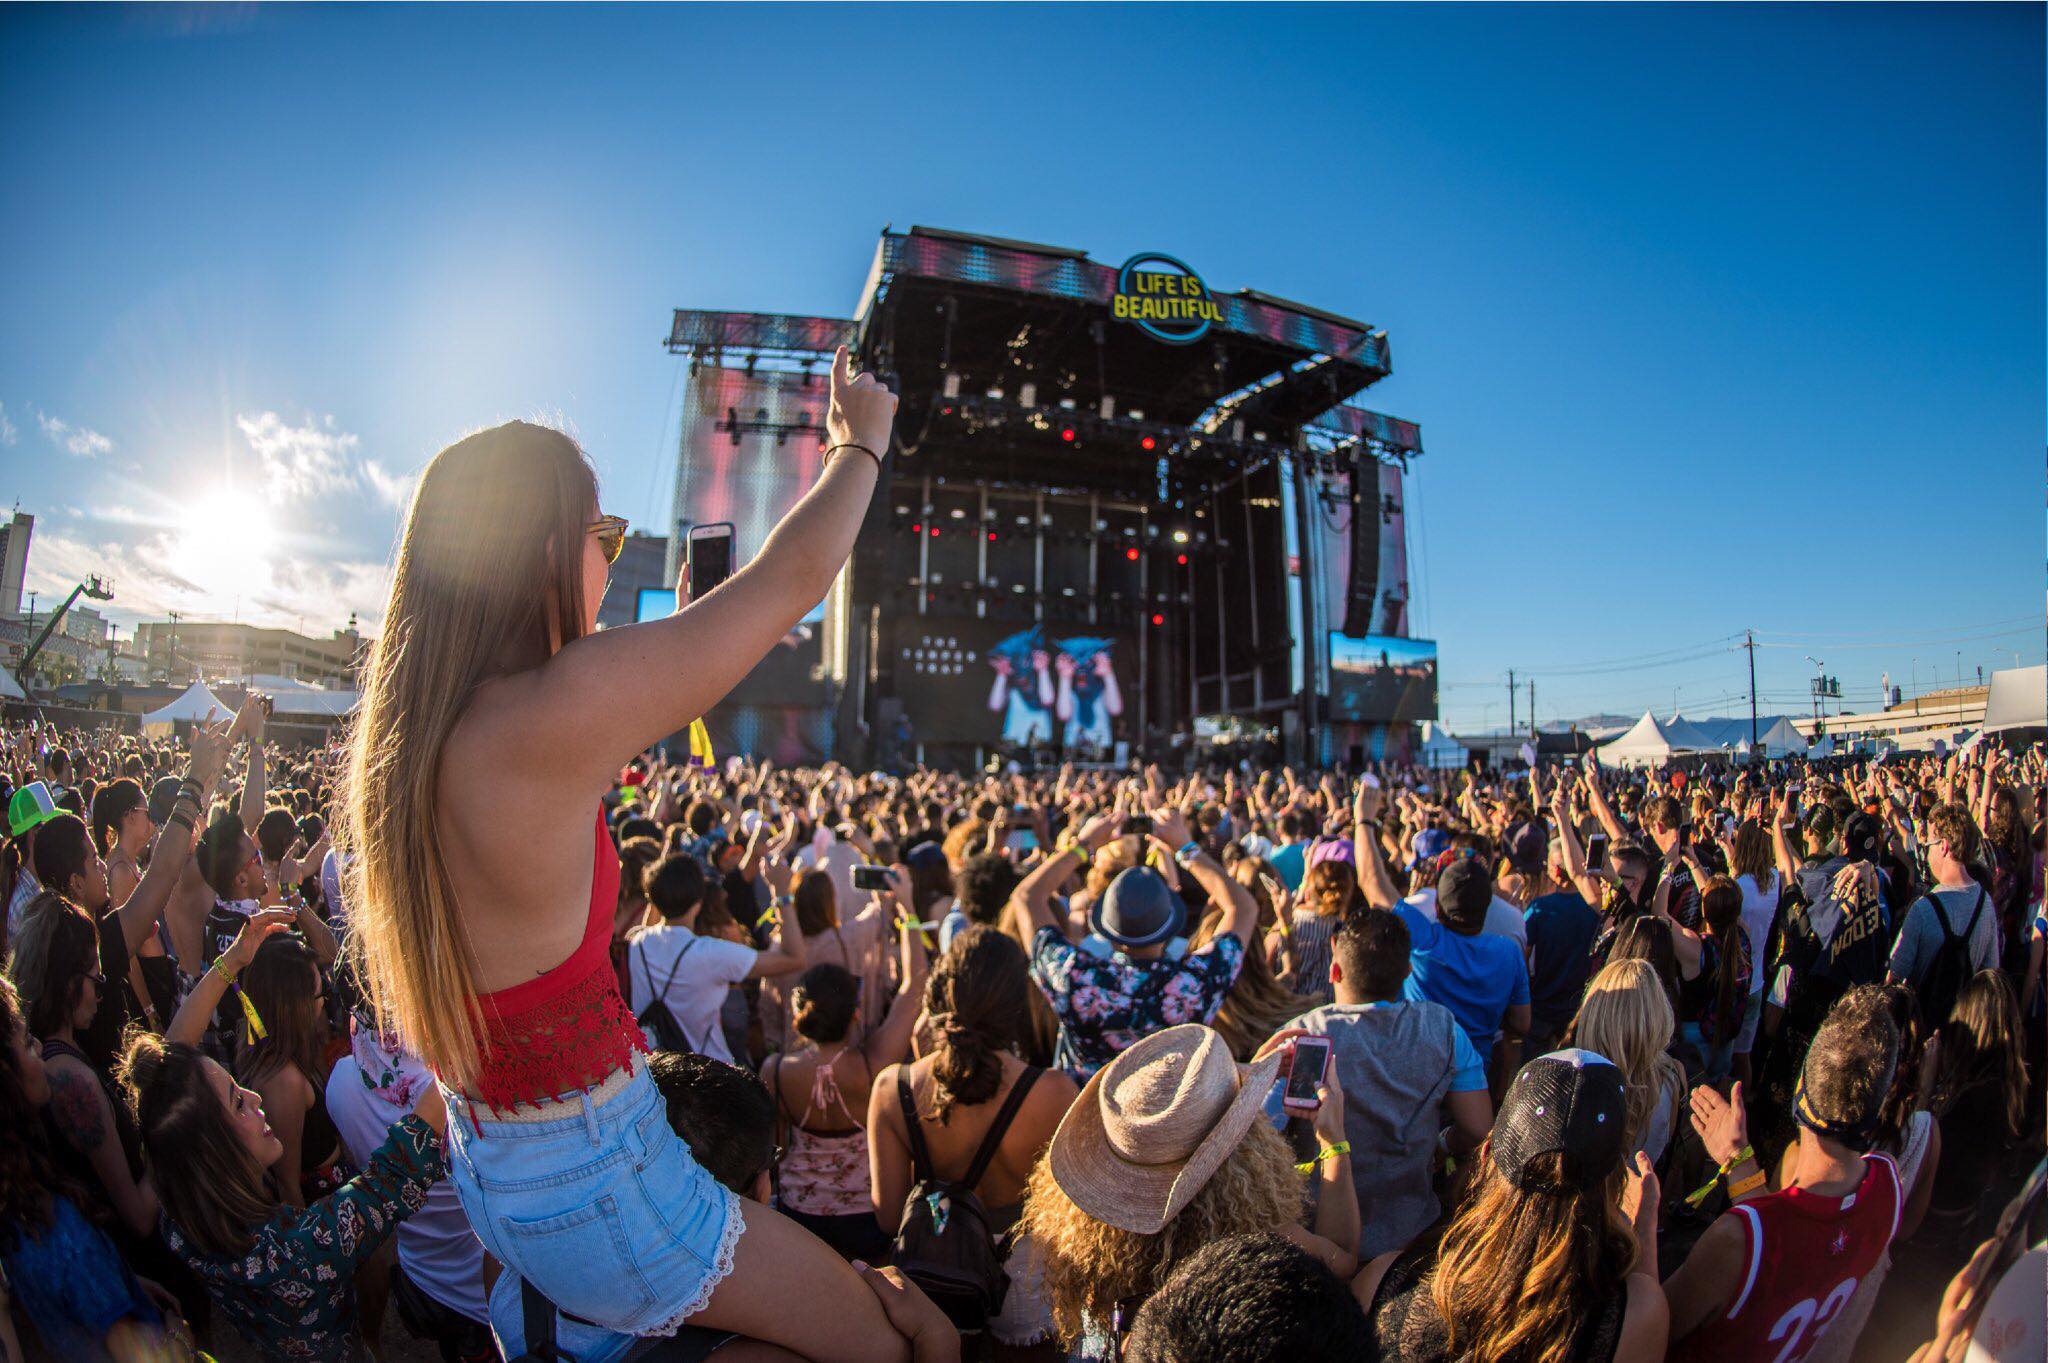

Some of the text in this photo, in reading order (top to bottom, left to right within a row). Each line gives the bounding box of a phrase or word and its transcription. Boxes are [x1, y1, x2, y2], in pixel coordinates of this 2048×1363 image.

[1136, 272, 1202, 296] LIFE IS
[1114, 294, 1224, 322] BEAUTIFUL
